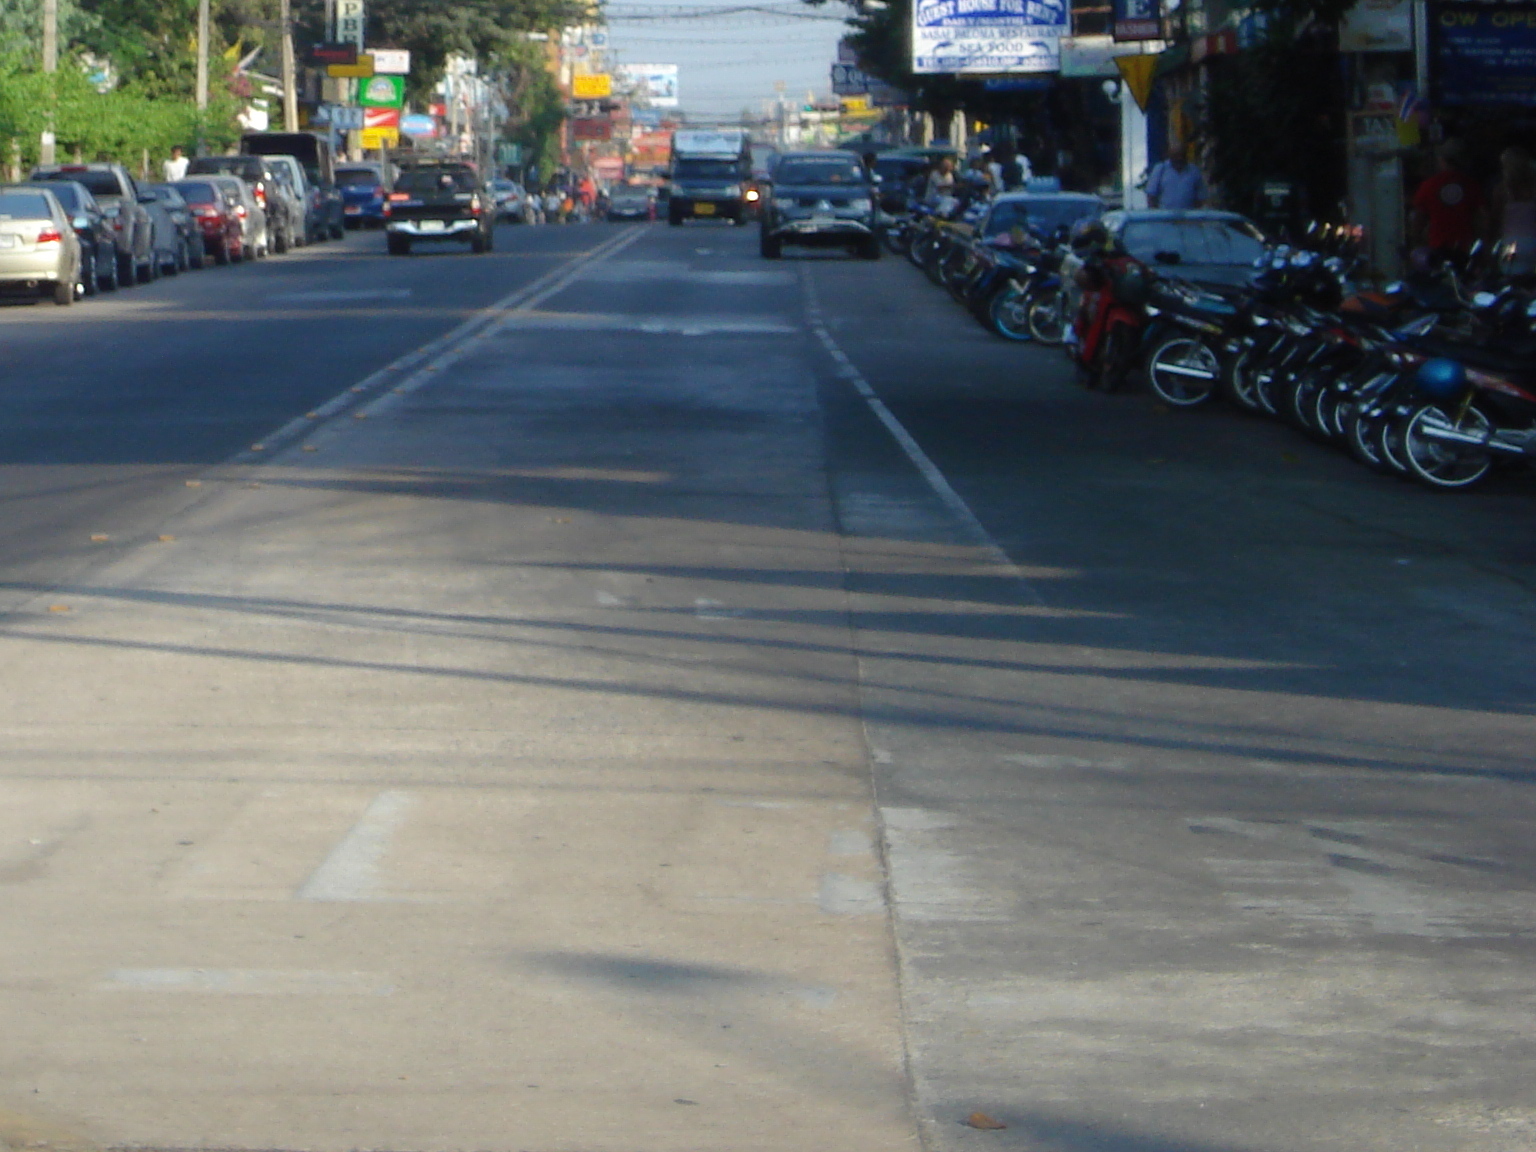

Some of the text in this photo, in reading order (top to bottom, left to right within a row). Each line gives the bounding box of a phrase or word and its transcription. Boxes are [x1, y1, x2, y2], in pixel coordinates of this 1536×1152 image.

[918, 0, 955, 26] GUEST
[1026, 0, 1059, 25] RENT
[958, 42, 1024, 53] SEA FOOD
